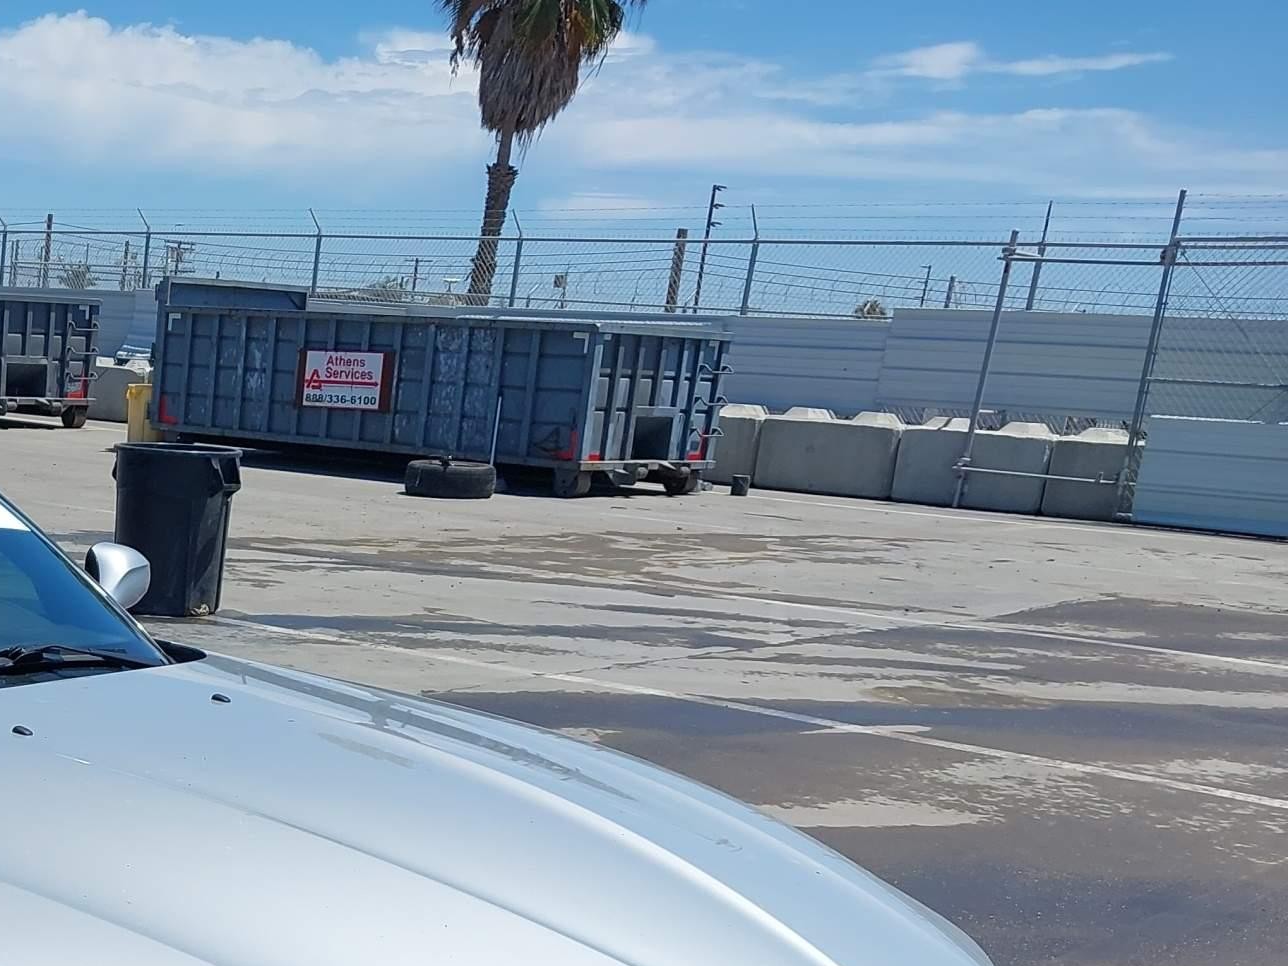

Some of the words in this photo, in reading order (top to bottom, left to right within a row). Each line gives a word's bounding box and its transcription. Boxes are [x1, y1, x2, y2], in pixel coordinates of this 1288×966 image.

[326, 355, 366, 368] Athens
[325, 367, 374, 381] Services
[305, 393, 377, 406] 888/336-6100
